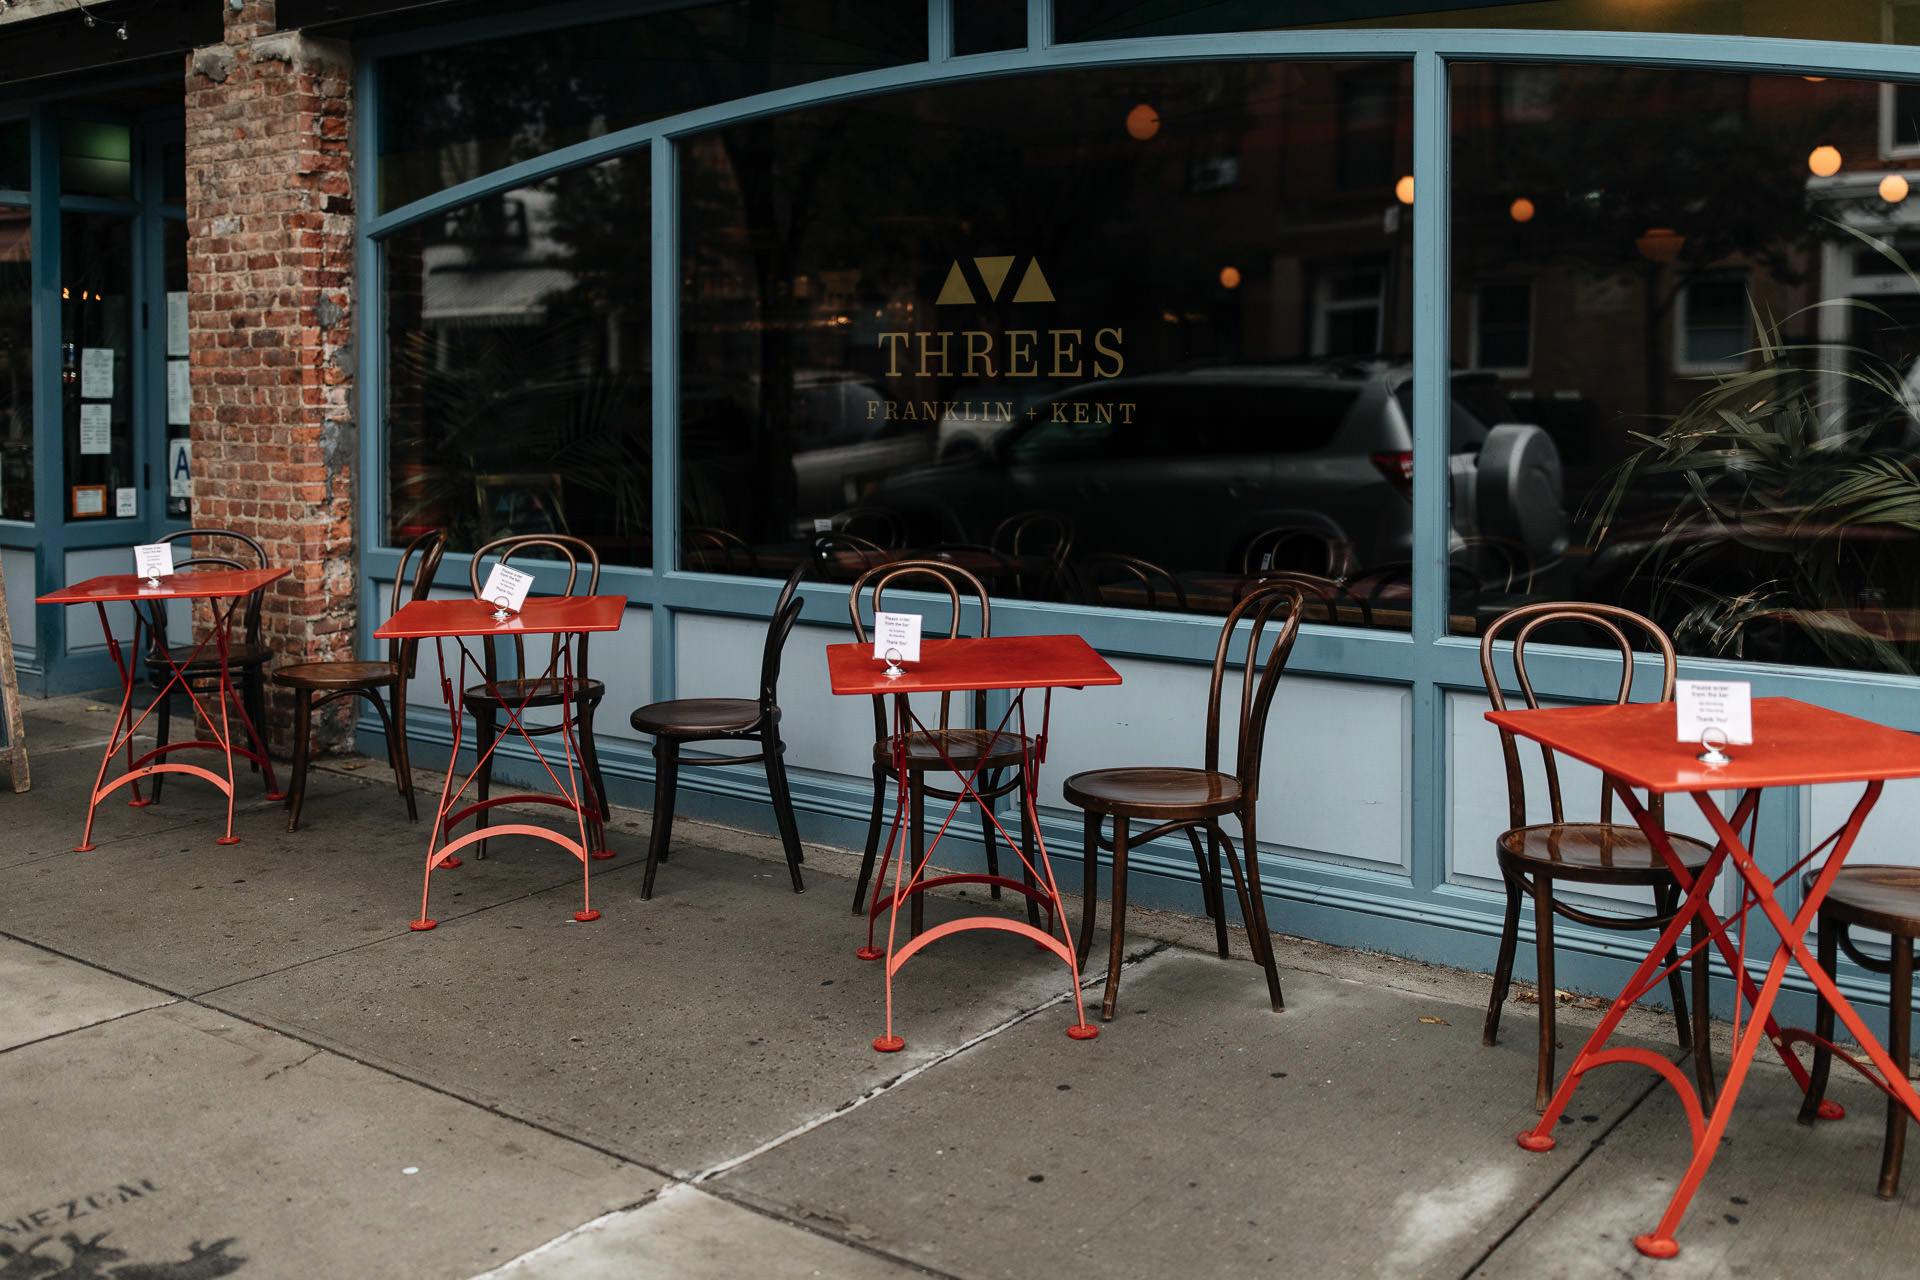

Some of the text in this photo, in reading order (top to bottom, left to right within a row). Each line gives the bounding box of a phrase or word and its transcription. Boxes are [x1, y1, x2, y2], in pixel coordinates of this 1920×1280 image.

[878, 327, 1124, 378] THREES
[866, 400, 1013, 422] FRANKLIN
[1050, 402, 1137, 424] KENT
[174, 446, 191, 480] A
